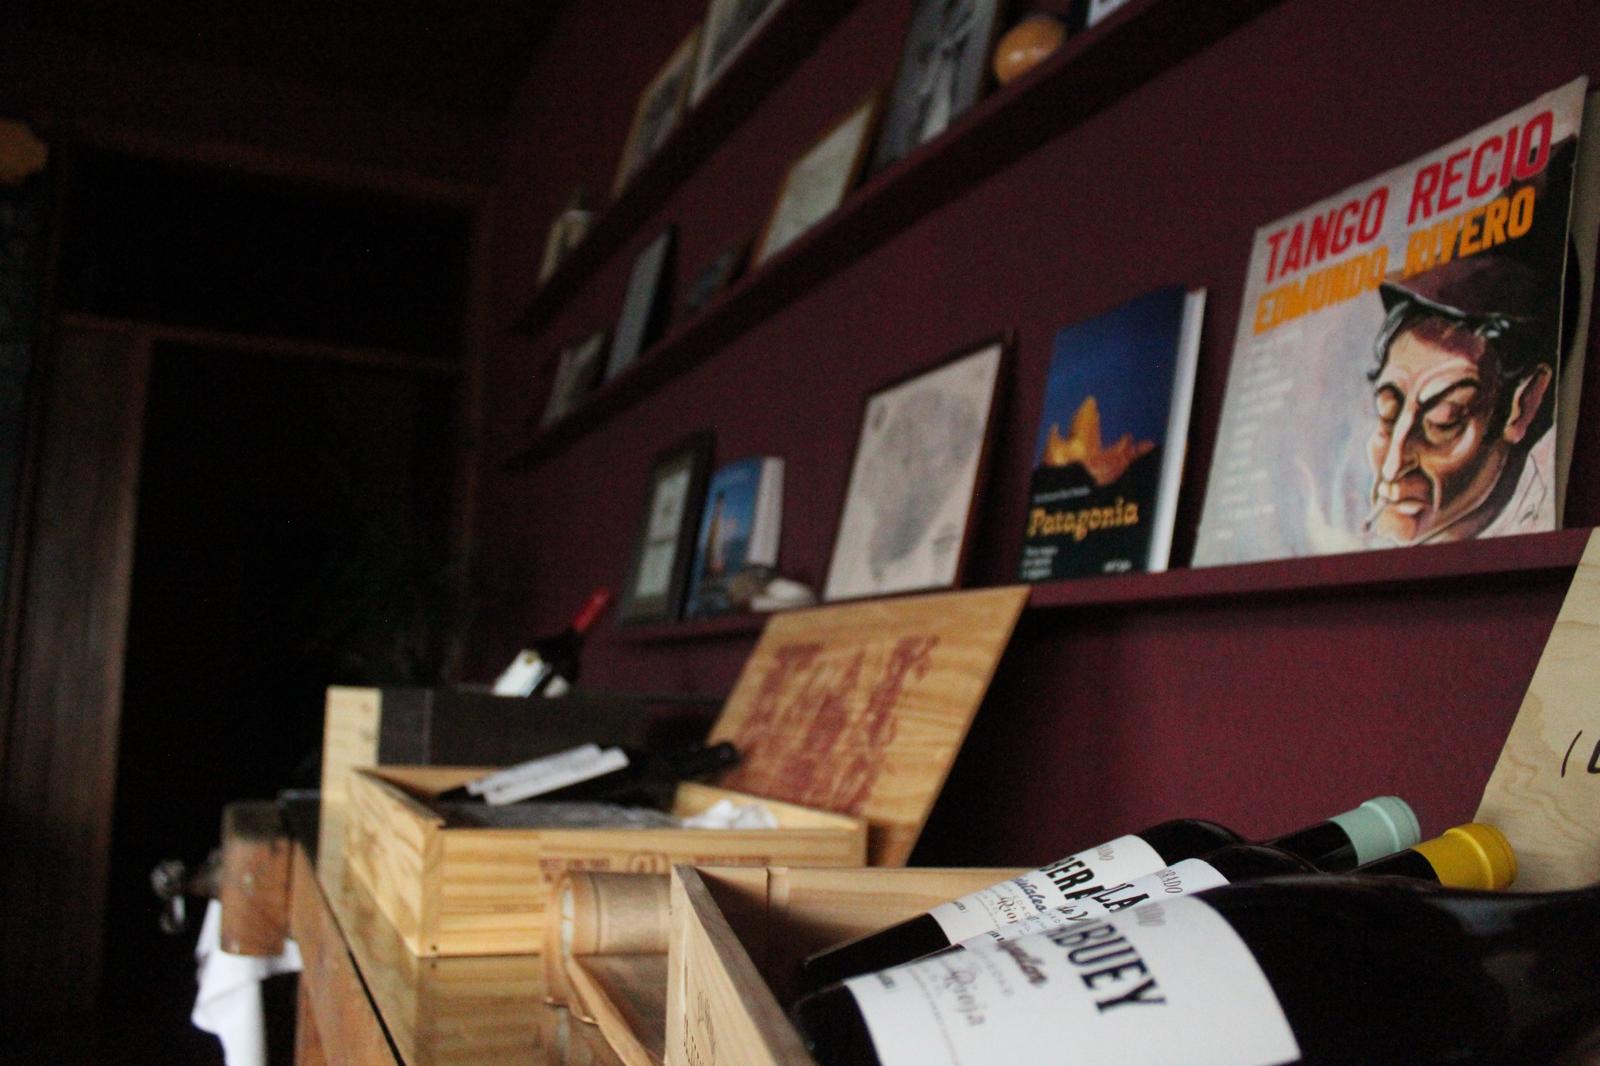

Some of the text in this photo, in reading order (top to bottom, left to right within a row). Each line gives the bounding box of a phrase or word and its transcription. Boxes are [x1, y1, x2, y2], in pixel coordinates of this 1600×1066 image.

[1254, 186, 1536, 336] EDMUNDO RIVERO
[1266, 111, 1554, 284] TANGO RECIO
[1028, 497, 1139, 541] Patagonia
